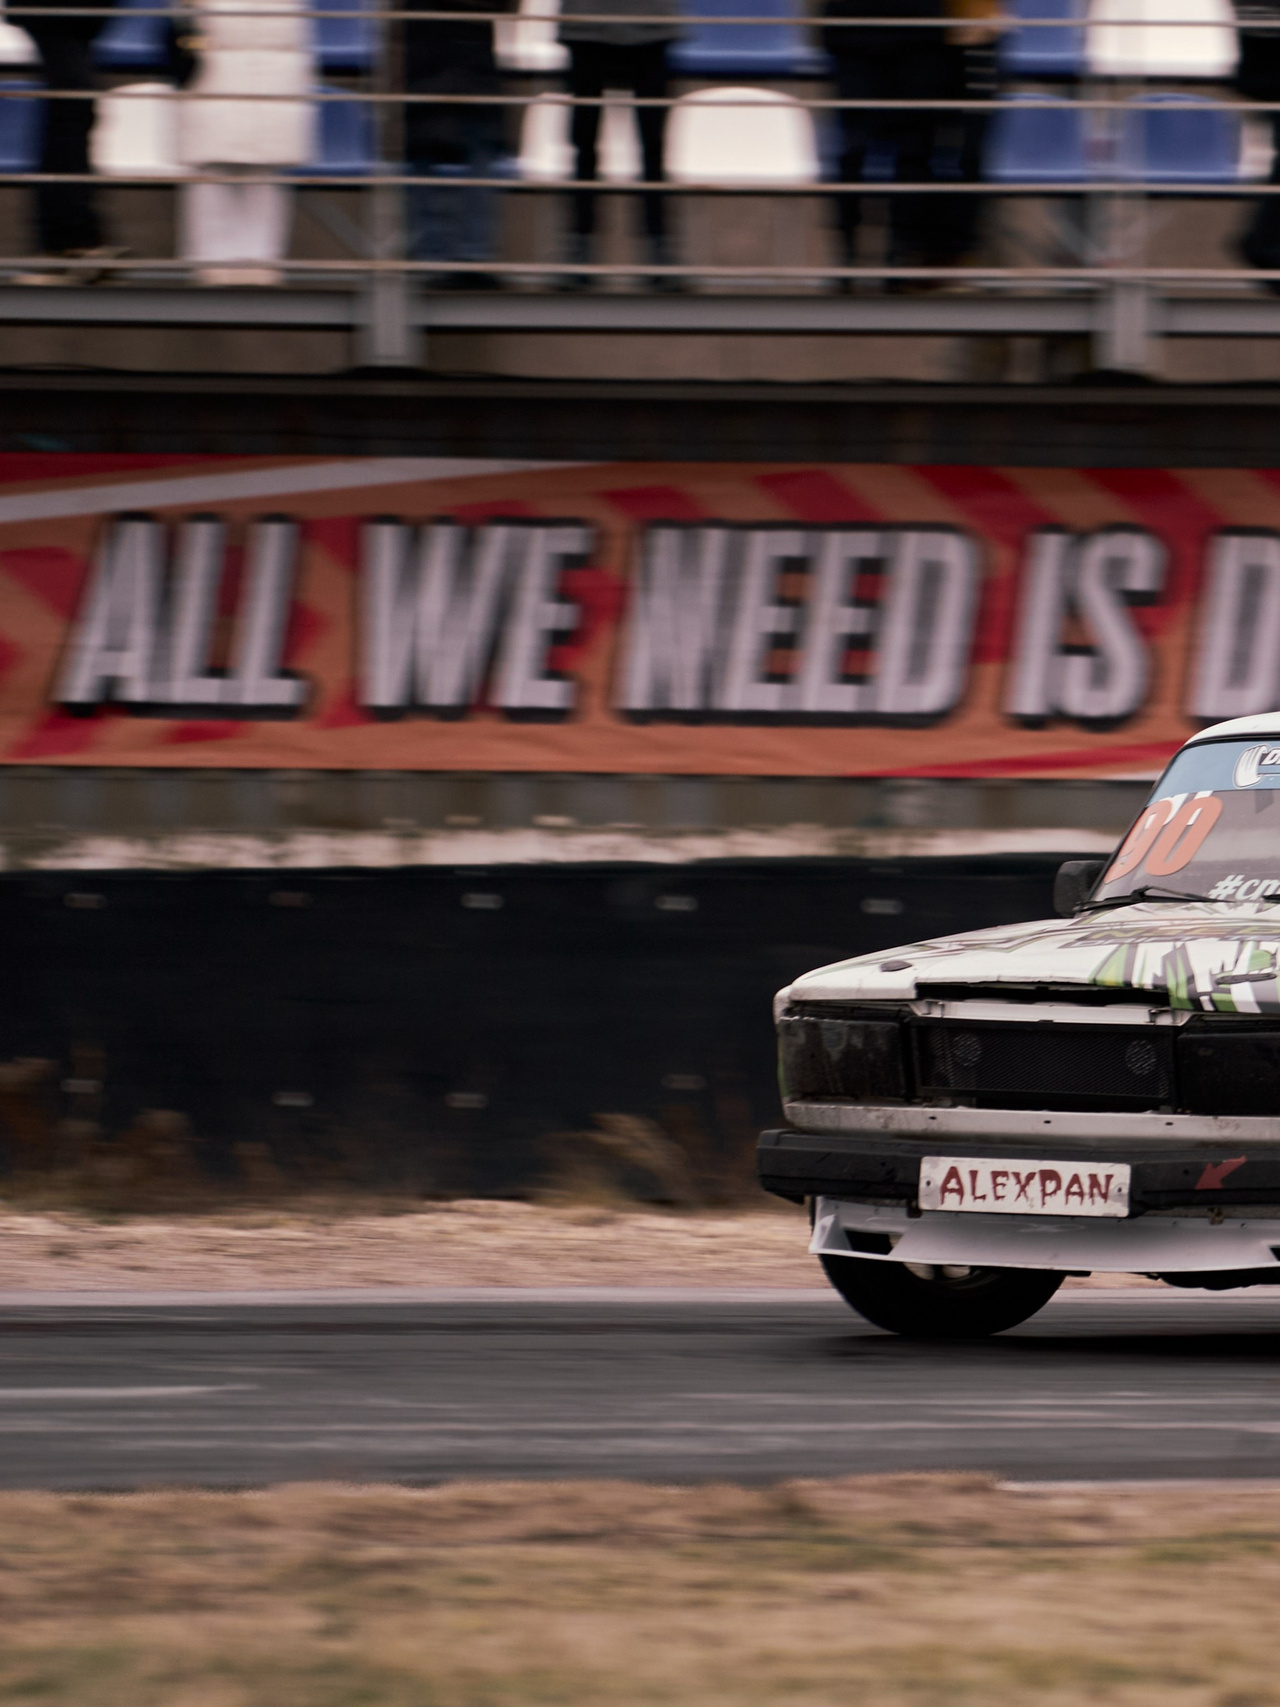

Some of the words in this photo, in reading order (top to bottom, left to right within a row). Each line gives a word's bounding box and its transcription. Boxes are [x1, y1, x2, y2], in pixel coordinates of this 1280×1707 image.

[54, 512, 310, 718] ALL
[358, 515, 594, 720] WE
[614, 519, 980, 726] NEED
[1008, 524, 1168, 729] IS
[940, 1166, 1114, 1208] ALEXPAN
